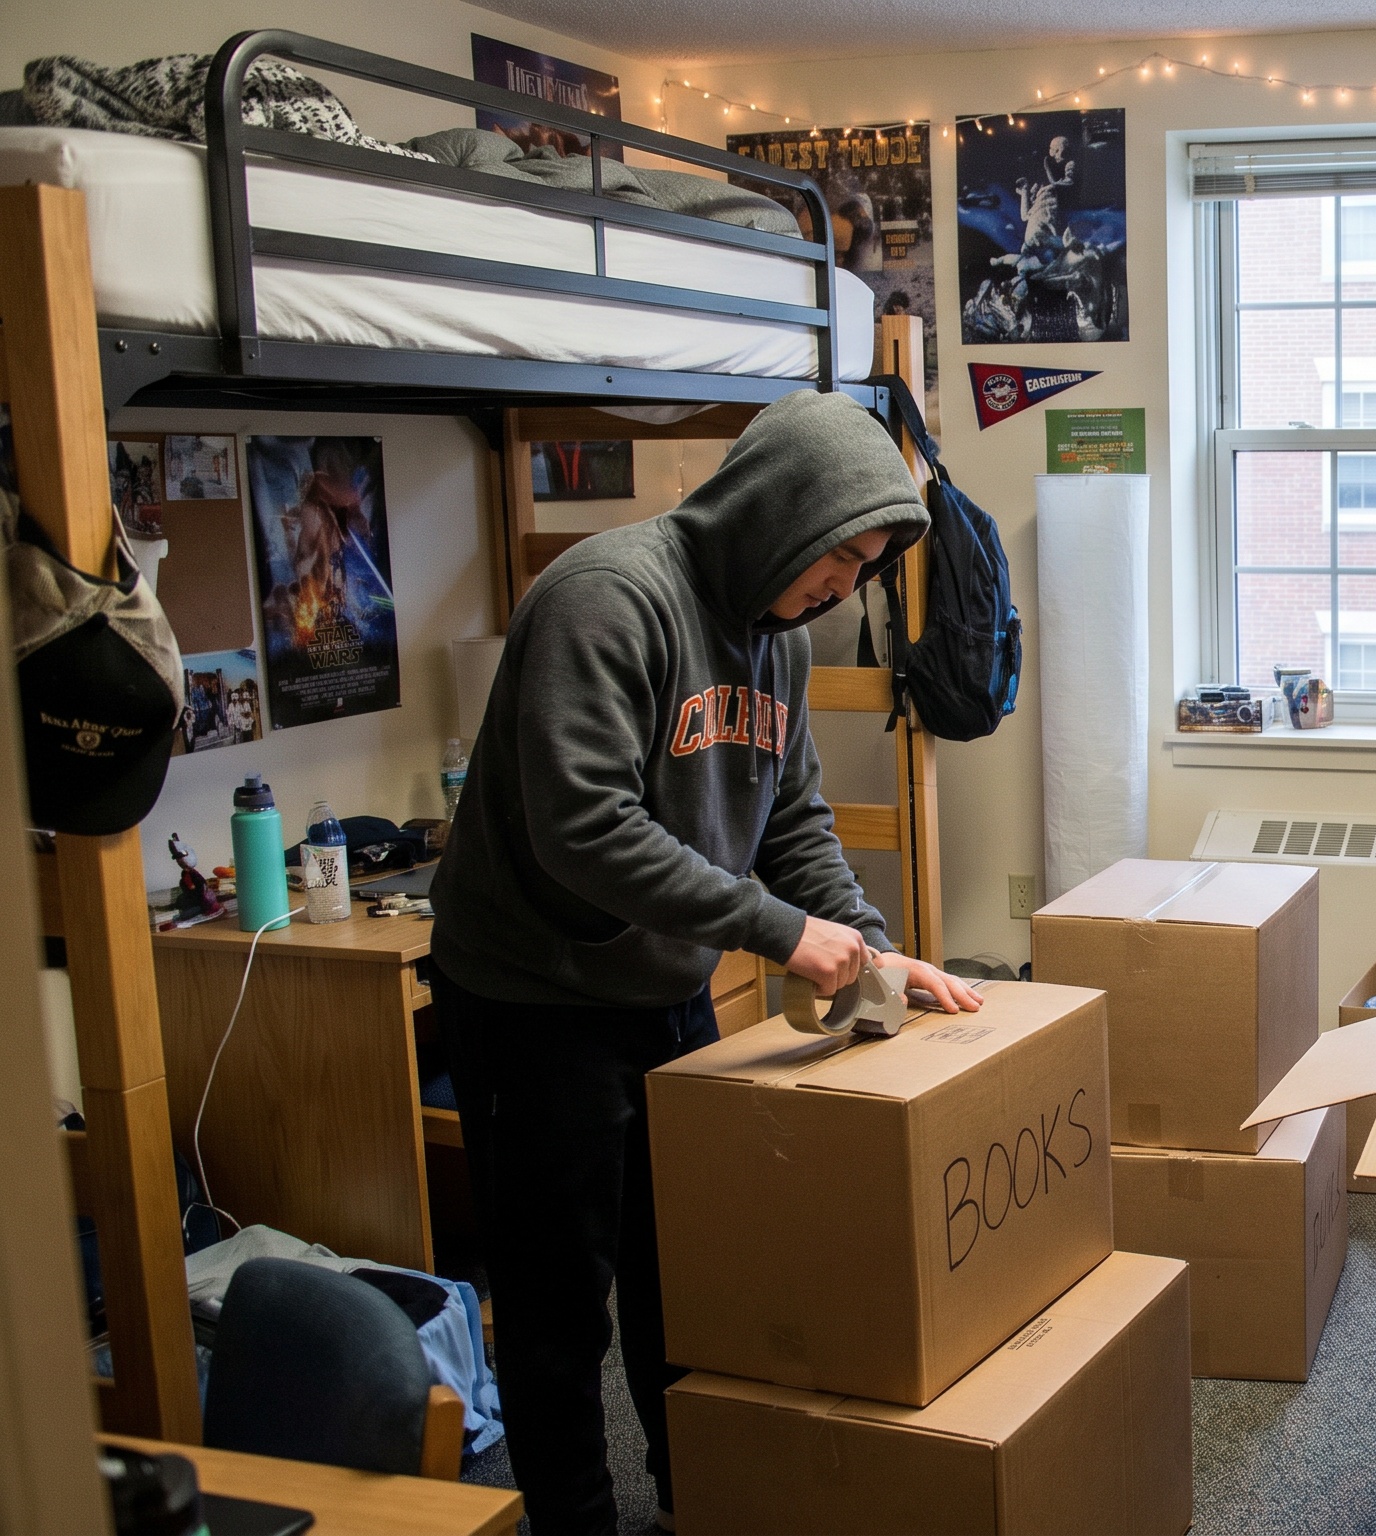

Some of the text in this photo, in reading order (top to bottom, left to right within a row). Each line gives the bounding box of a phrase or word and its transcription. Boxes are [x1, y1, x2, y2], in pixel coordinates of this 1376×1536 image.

[307, 624, 361, 646] STAR
[308, 647, 363, 669] WARS
[942, 1087, 1093, 1272] BOOKS
